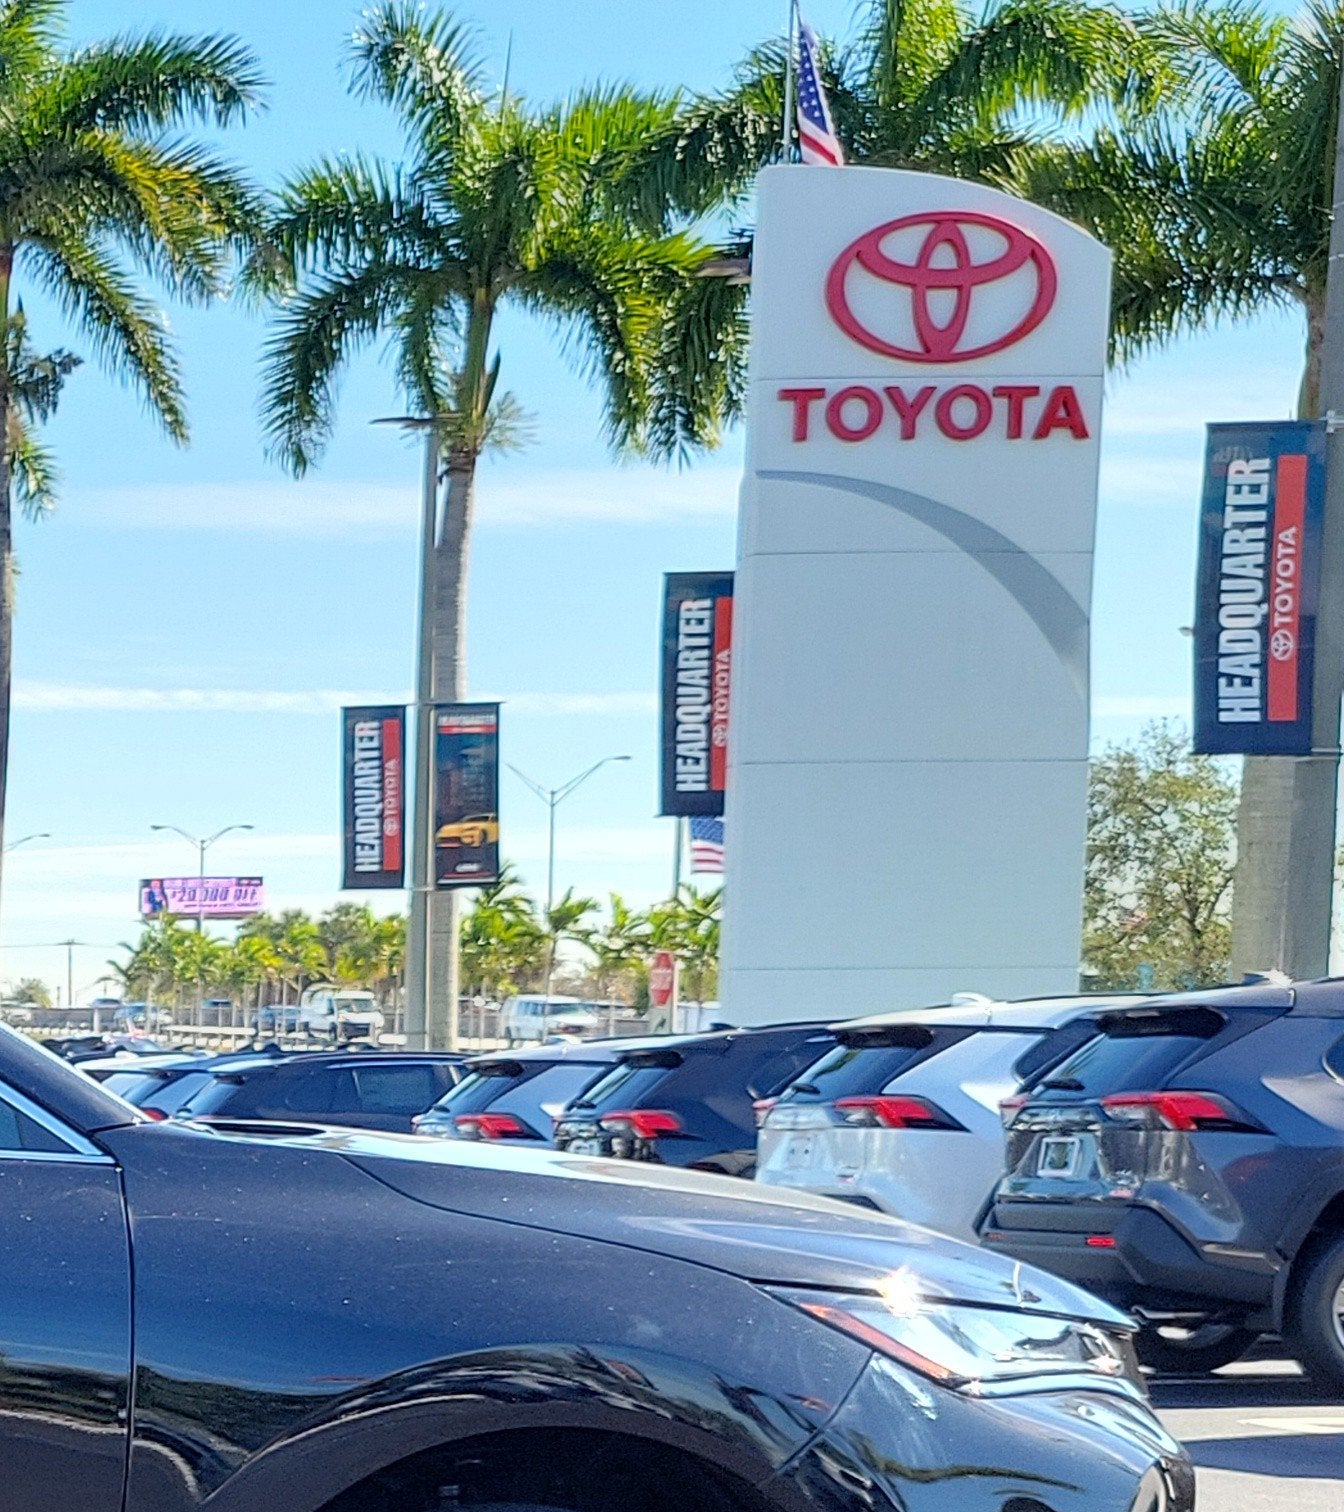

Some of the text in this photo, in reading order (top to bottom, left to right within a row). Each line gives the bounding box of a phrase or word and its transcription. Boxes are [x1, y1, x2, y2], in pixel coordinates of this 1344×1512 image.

[778, 384, 1090, 443] TOYOTA
[1218, 457, 1272, 723] HEADQUARTER
[1274, 526, 1298, 627] TOYOTA
[675, 597, 712, 792] HEADQUARTER
[714, 648, 731, 724] TOYOTA
[354, 721, 381, 872] HEADQUARTER
